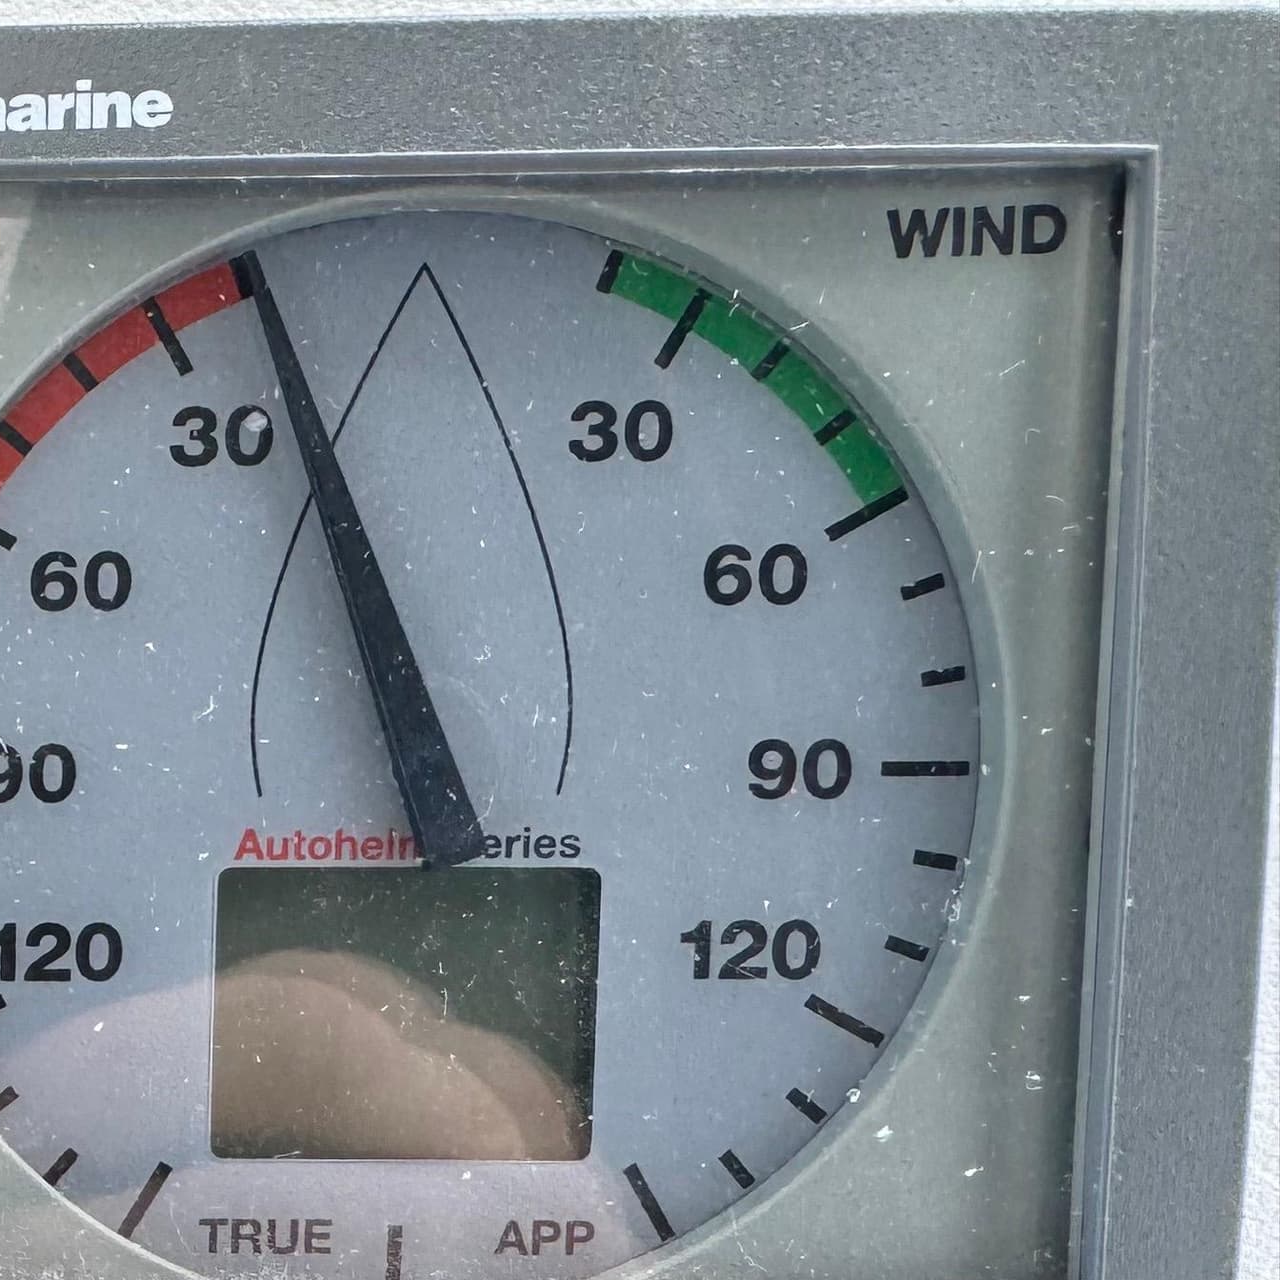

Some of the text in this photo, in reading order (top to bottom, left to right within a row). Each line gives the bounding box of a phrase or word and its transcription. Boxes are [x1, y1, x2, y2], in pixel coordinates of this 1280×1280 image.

[887, 204, 1067, 258] WIND
[169, 405, 274, 467] 30
[568, 400, 674, 462] 30
[30, 550, 133, 611] 60
[703, 543, 808, 606] 60
[748, 739, 852, 800] 90
[481, 827, 581, 859] eries
[680, 919, 821, 981] 120
[199, 1218, 333, 1255] TRUE
[493, 1220, 596, 1256] APP
